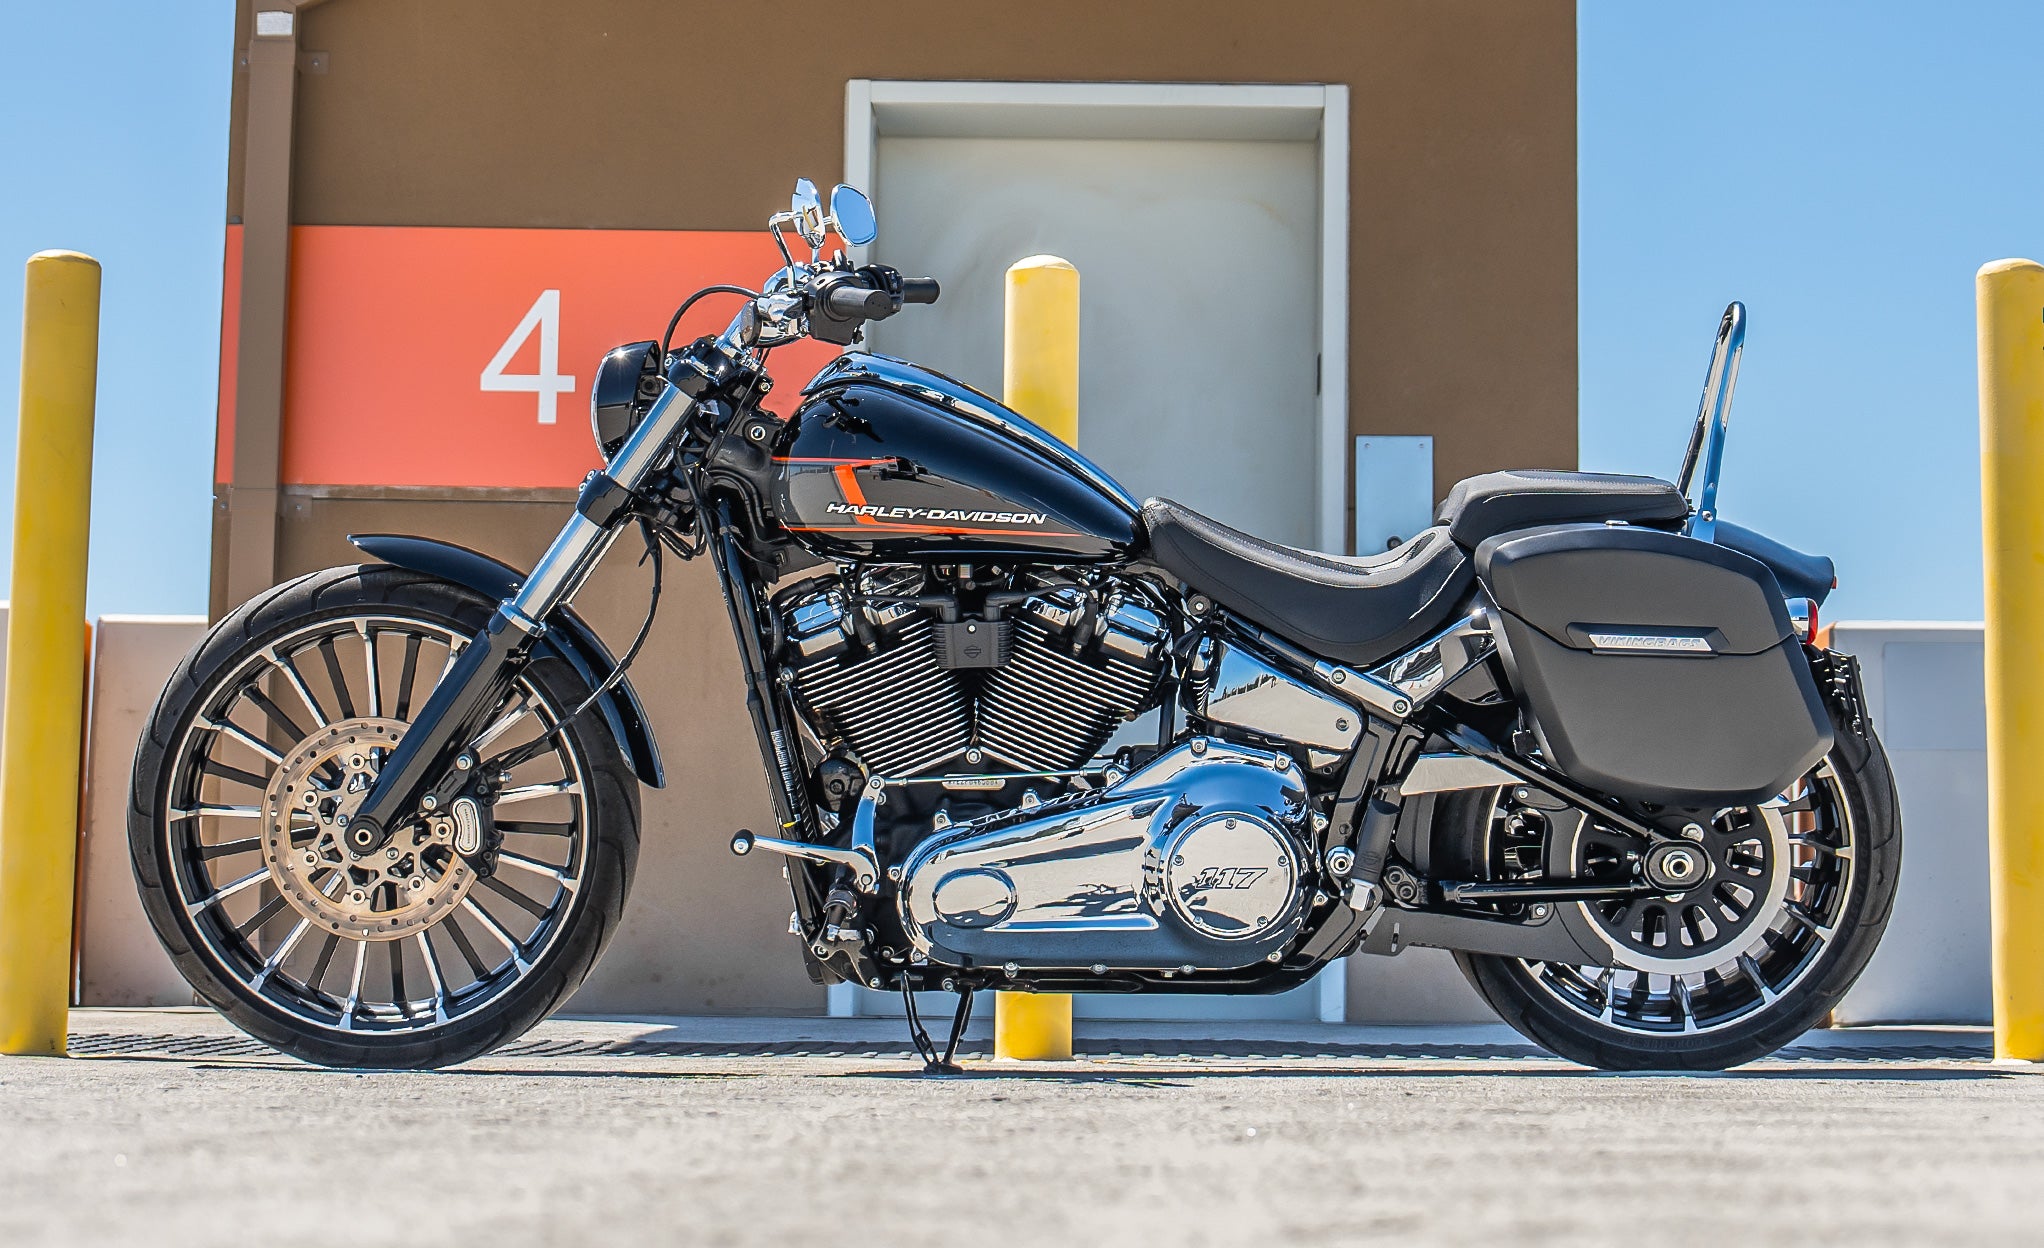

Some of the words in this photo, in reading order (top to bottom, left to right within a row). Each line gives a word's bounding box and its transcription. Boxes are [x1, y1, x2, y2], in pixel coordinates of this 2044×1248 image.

[480, 288, 576, 425] 4
[826, 502, 1047, 525] HARLEY-DAVIDSON
[1599, 635, 1701, 648] VIKINGBAGS
[1194, 867, 1269, 890] 117
